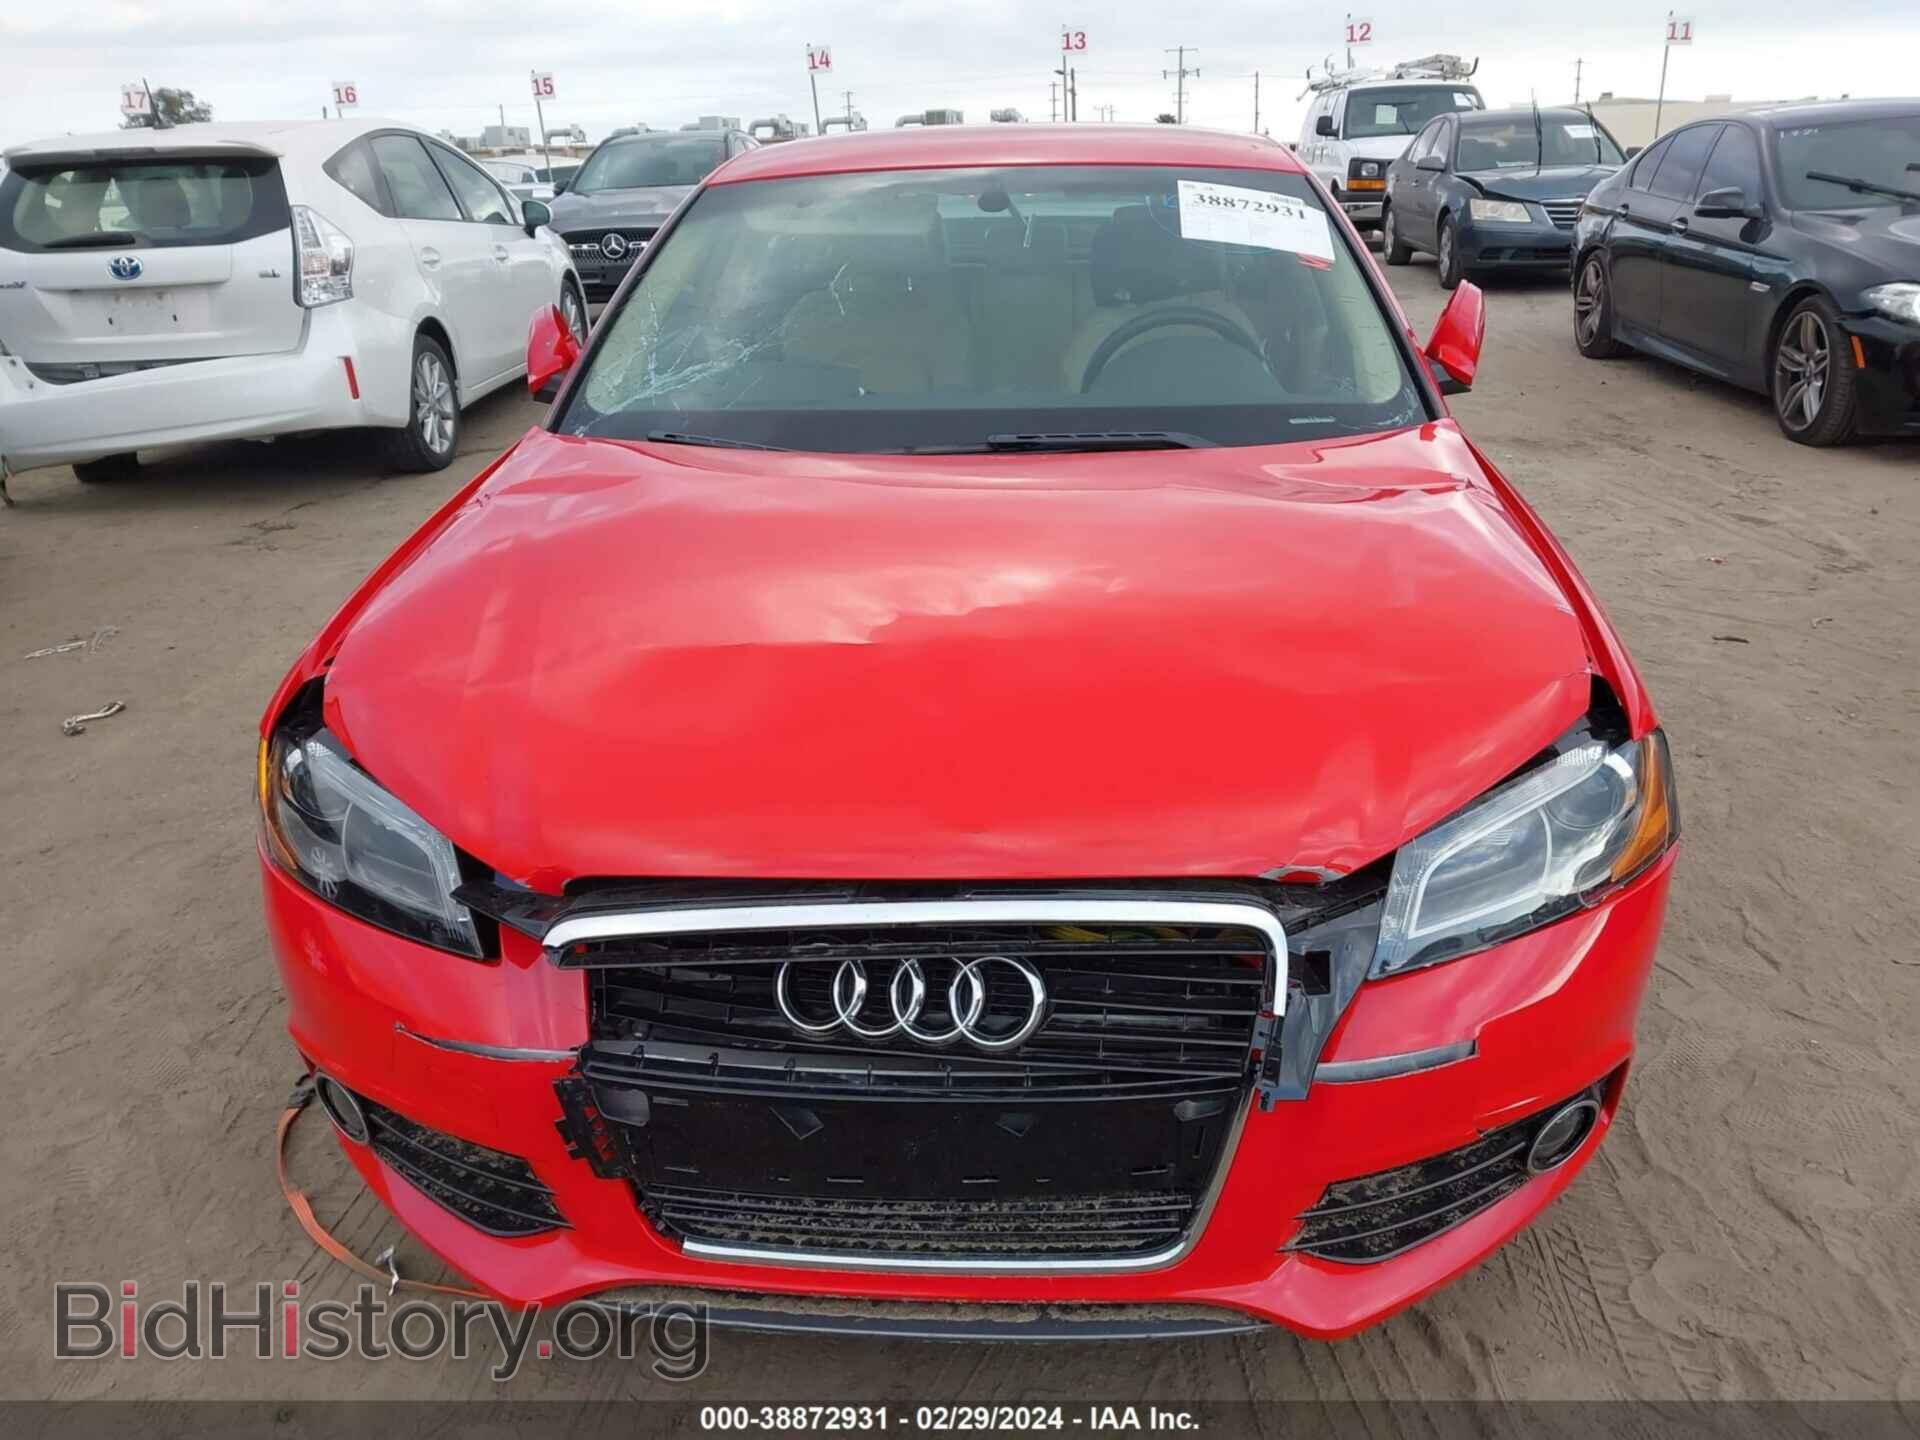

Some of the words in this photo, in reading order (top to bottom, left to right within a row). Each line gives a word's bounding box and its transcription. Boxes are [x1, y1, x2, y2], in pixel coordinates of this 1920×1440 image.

[1062, 31, 1086, 50] 13
[1346, 23, 1371, 42] 12
[1667, 22, 1692, 41] 11
[808, 51, 831, 70] 14
[332, 86, 356, 104] 16
[531, 77, 553, 96] 15
[121, 91, 146, 109] 17
[1192, 193, 1305, 220] 38872931
